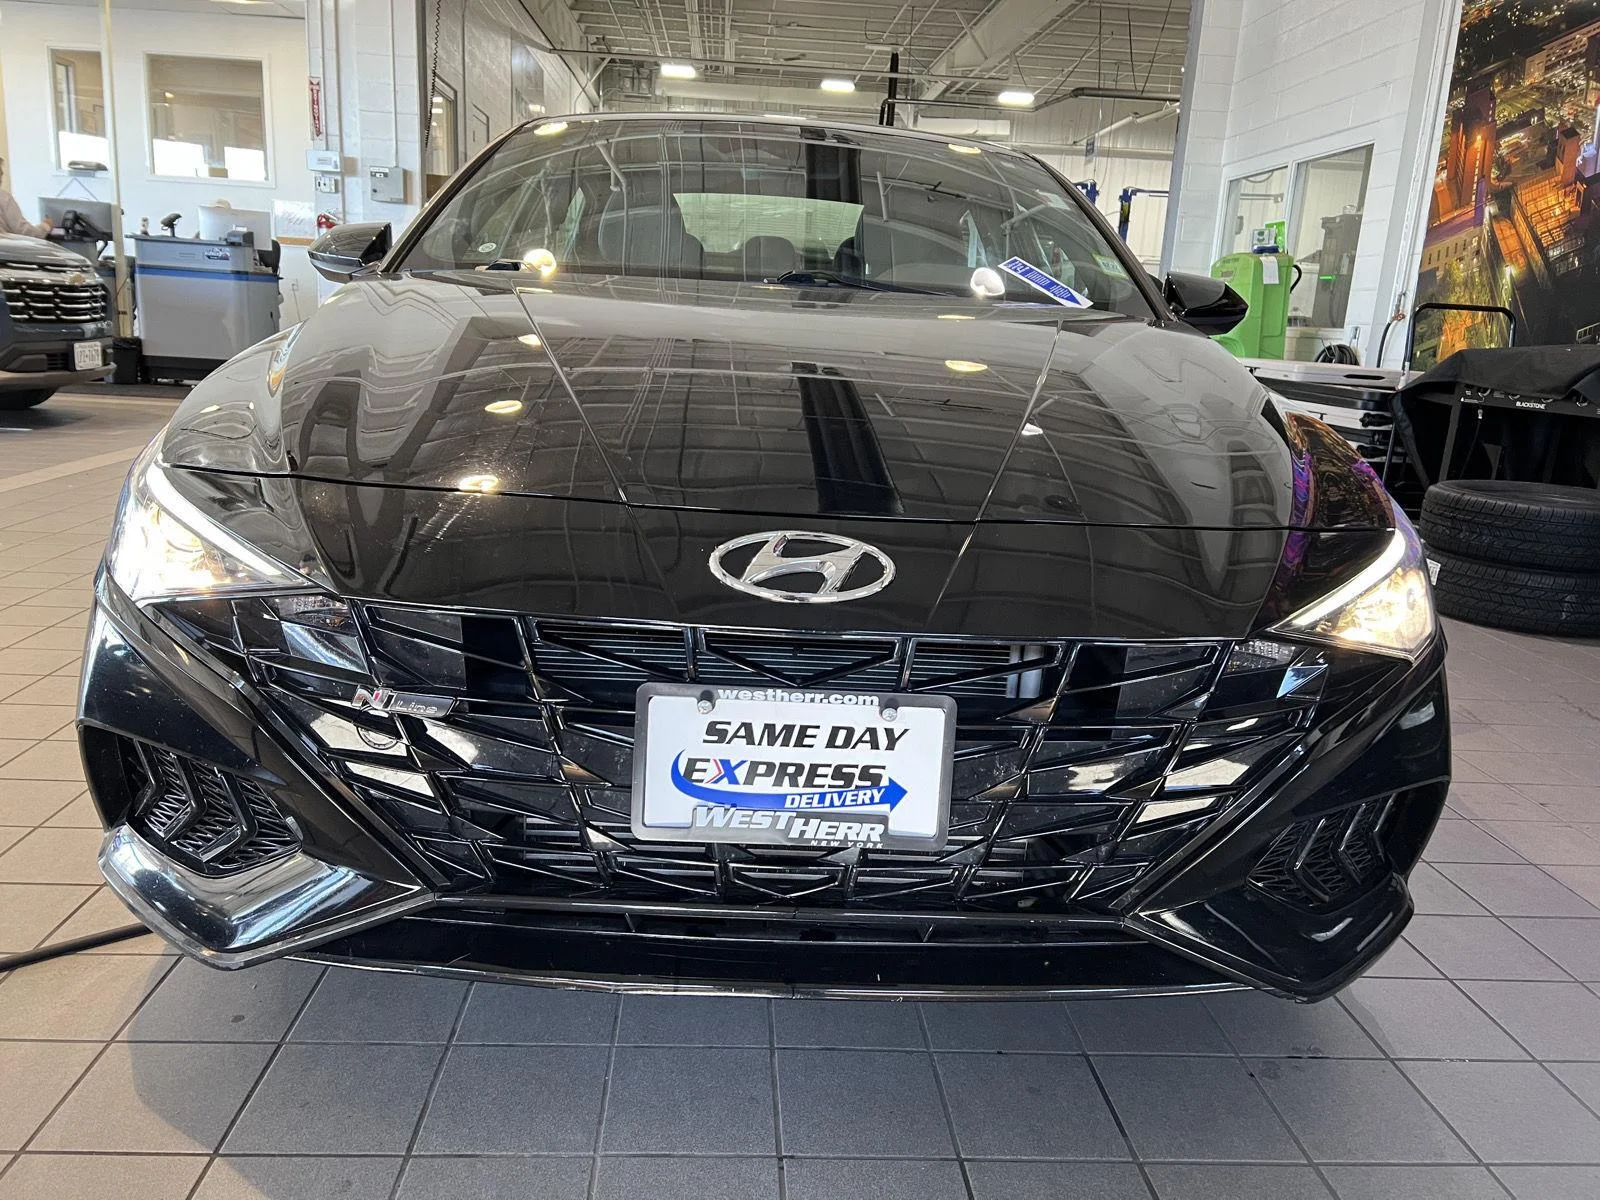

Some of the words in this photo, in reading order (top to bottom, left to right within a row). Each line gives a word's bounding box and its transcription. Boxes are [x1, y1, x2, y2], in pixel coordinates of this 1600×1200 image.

[1515, 401, 1546, 410] BLACKSTONE
[717, 688, 879, 706] westherr.com
[395, 700, 438, 714] Line
[702, 720, 821, 748] SAME
[825, 725, 910, 751] DAY
[682, 757, 886, 789] EXPRESS
[784, 788, 886, 809] DELIVERY
[847, 841, 884, 849] YORK
